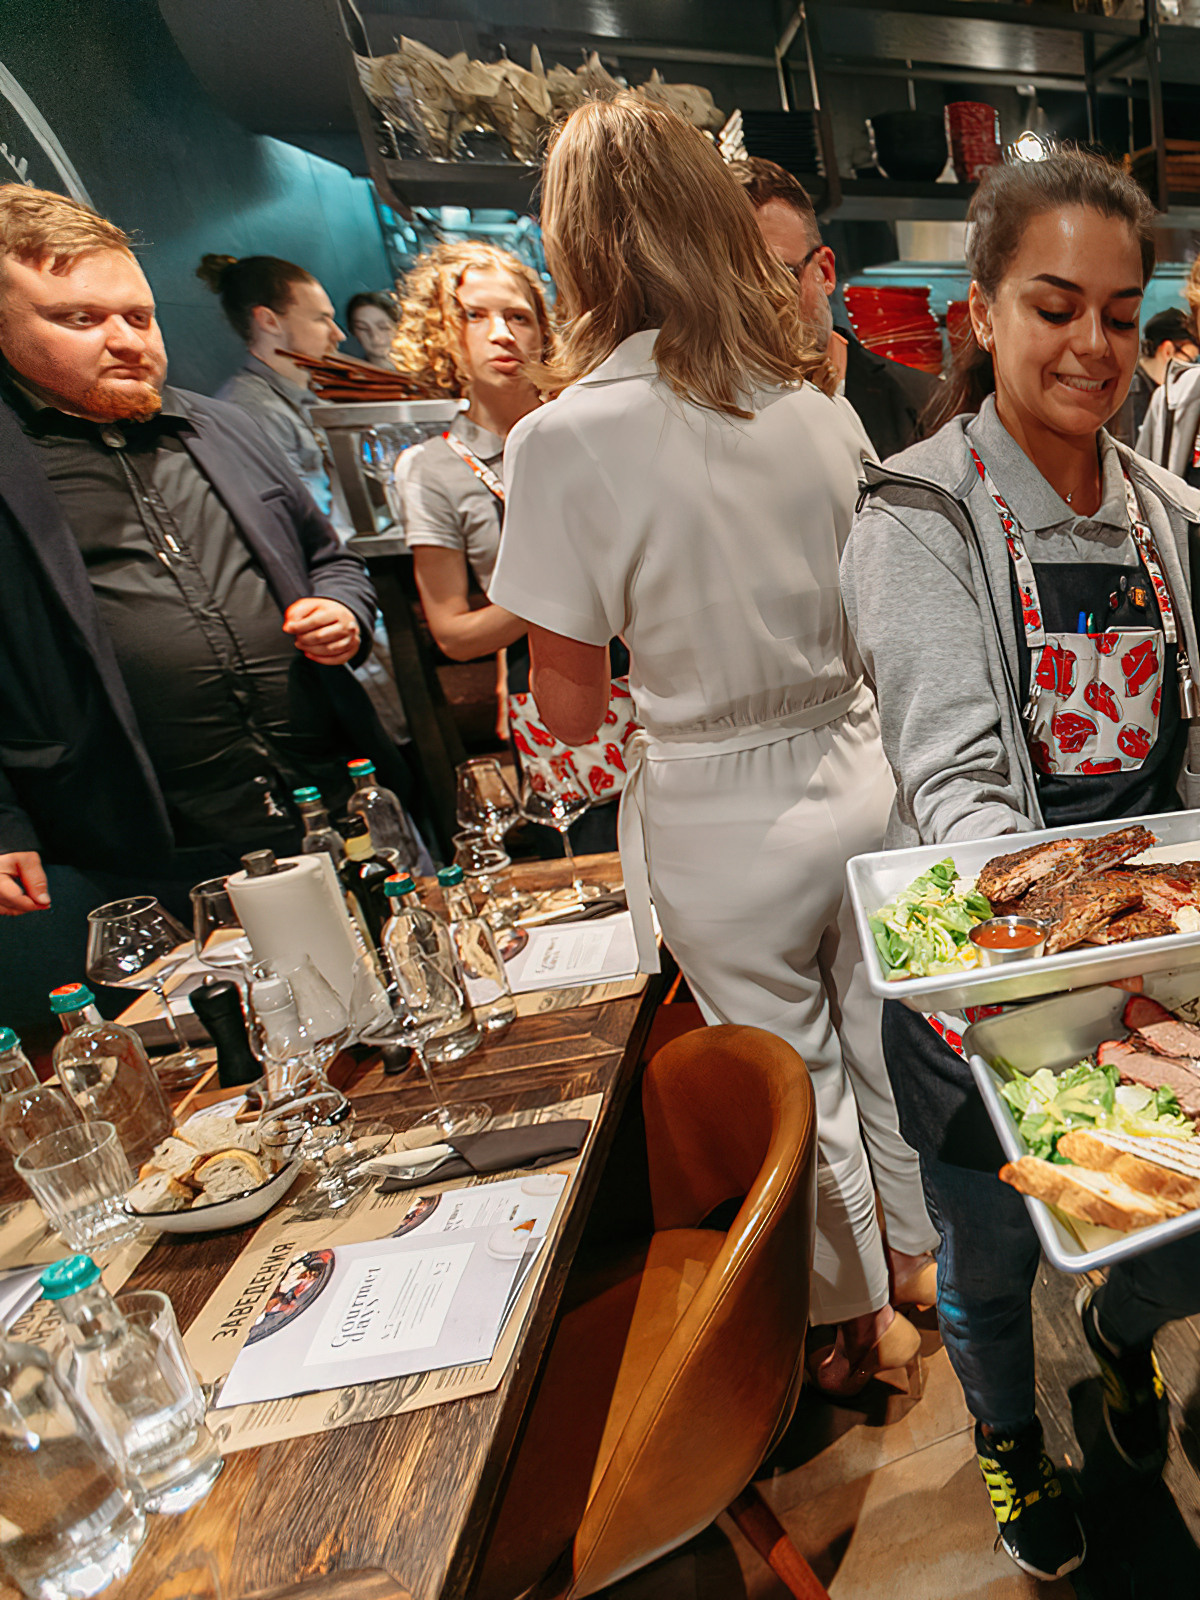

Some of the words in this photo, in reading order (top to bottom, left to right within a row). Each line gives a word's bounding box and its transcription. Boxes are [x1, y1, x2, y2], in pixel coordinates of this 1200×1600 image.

[211, 1241, 297, 1342] ЗАВЕДЕНИЯ
[331, 1267, 382, 1348] Gourmet
[351, 1298, 381, 1342] days
